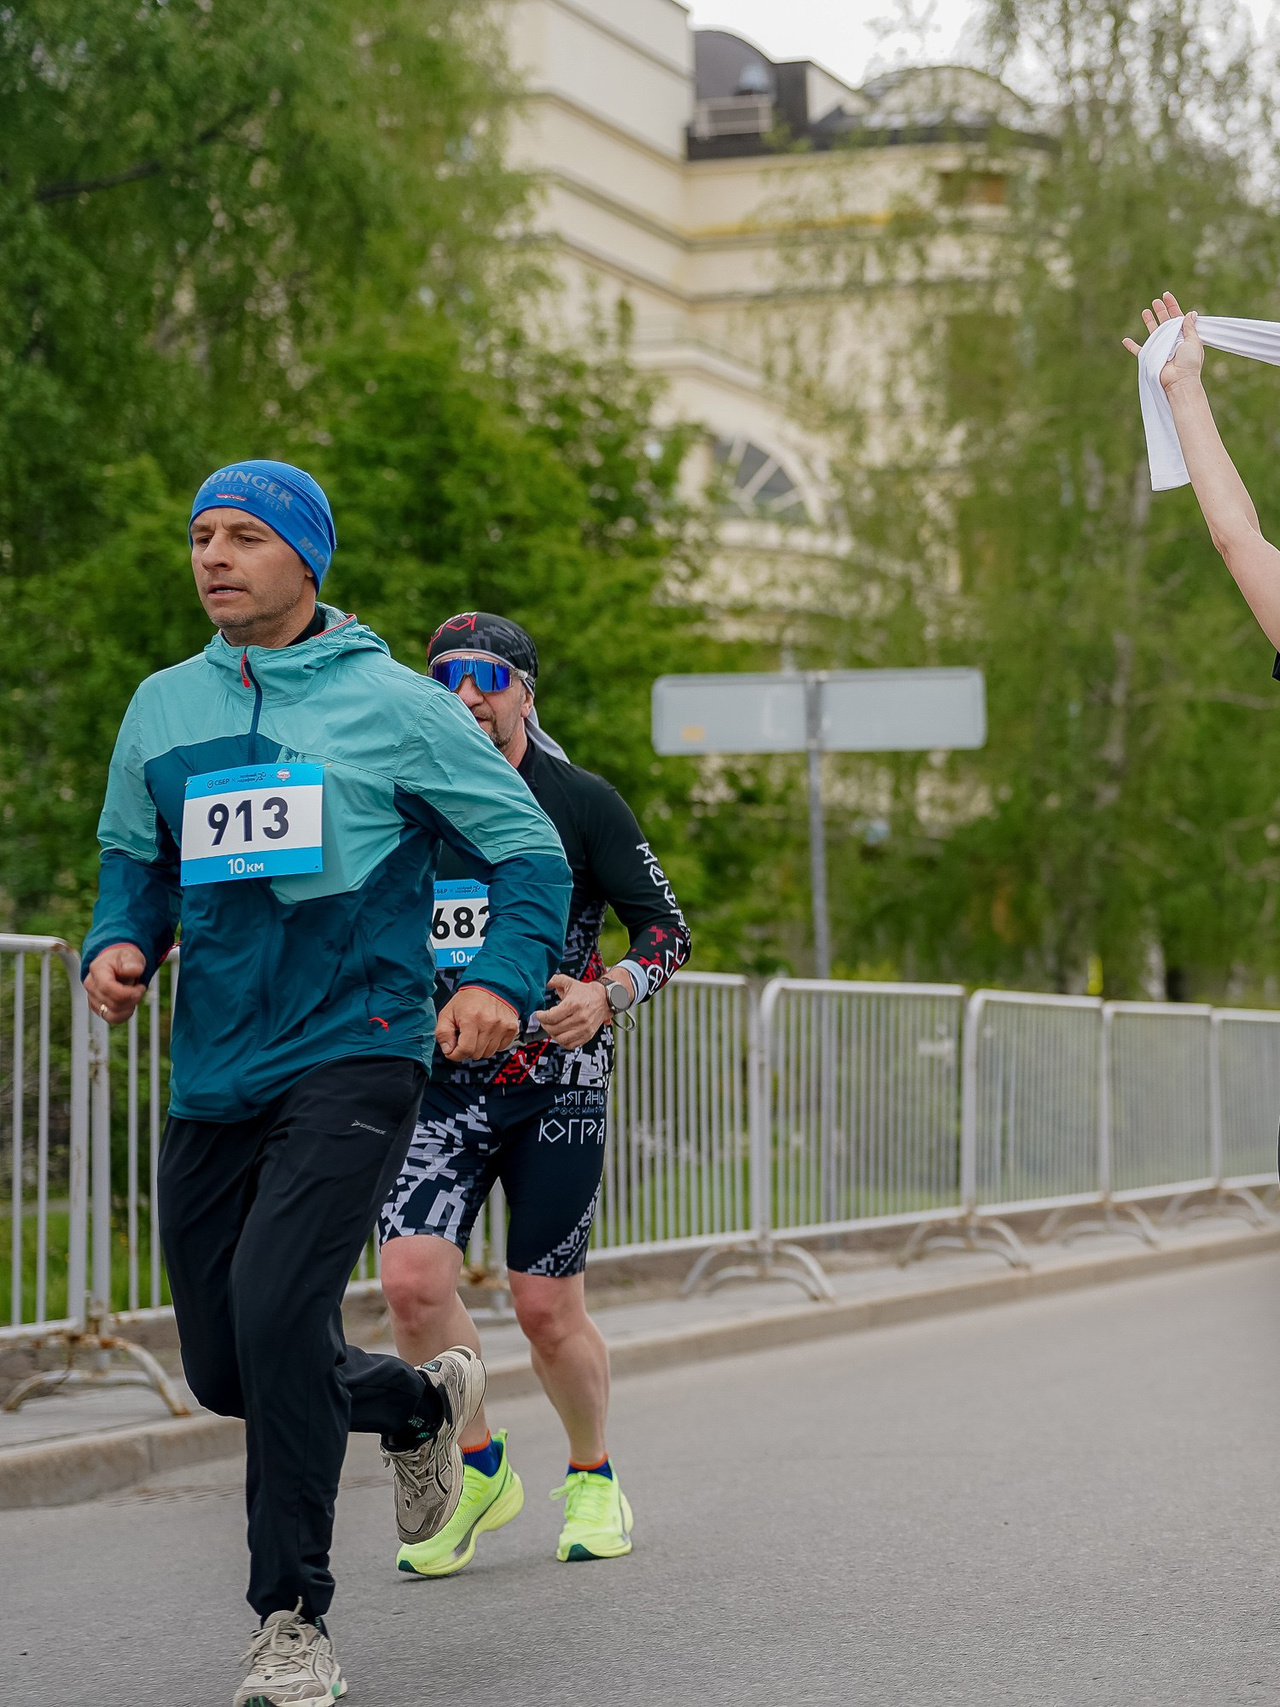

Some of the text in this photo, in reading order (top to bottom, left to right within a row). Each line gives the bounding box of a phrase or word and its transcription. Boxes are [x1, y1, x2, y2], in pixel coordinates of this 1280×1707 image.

[214, 778, 230, 786] СБЕР
[207, 796, 289, 846] 913
[554, 1089, 604, 1106] НЯГАНЬ
[538, 1118, 605, 1145] ЮГРА
